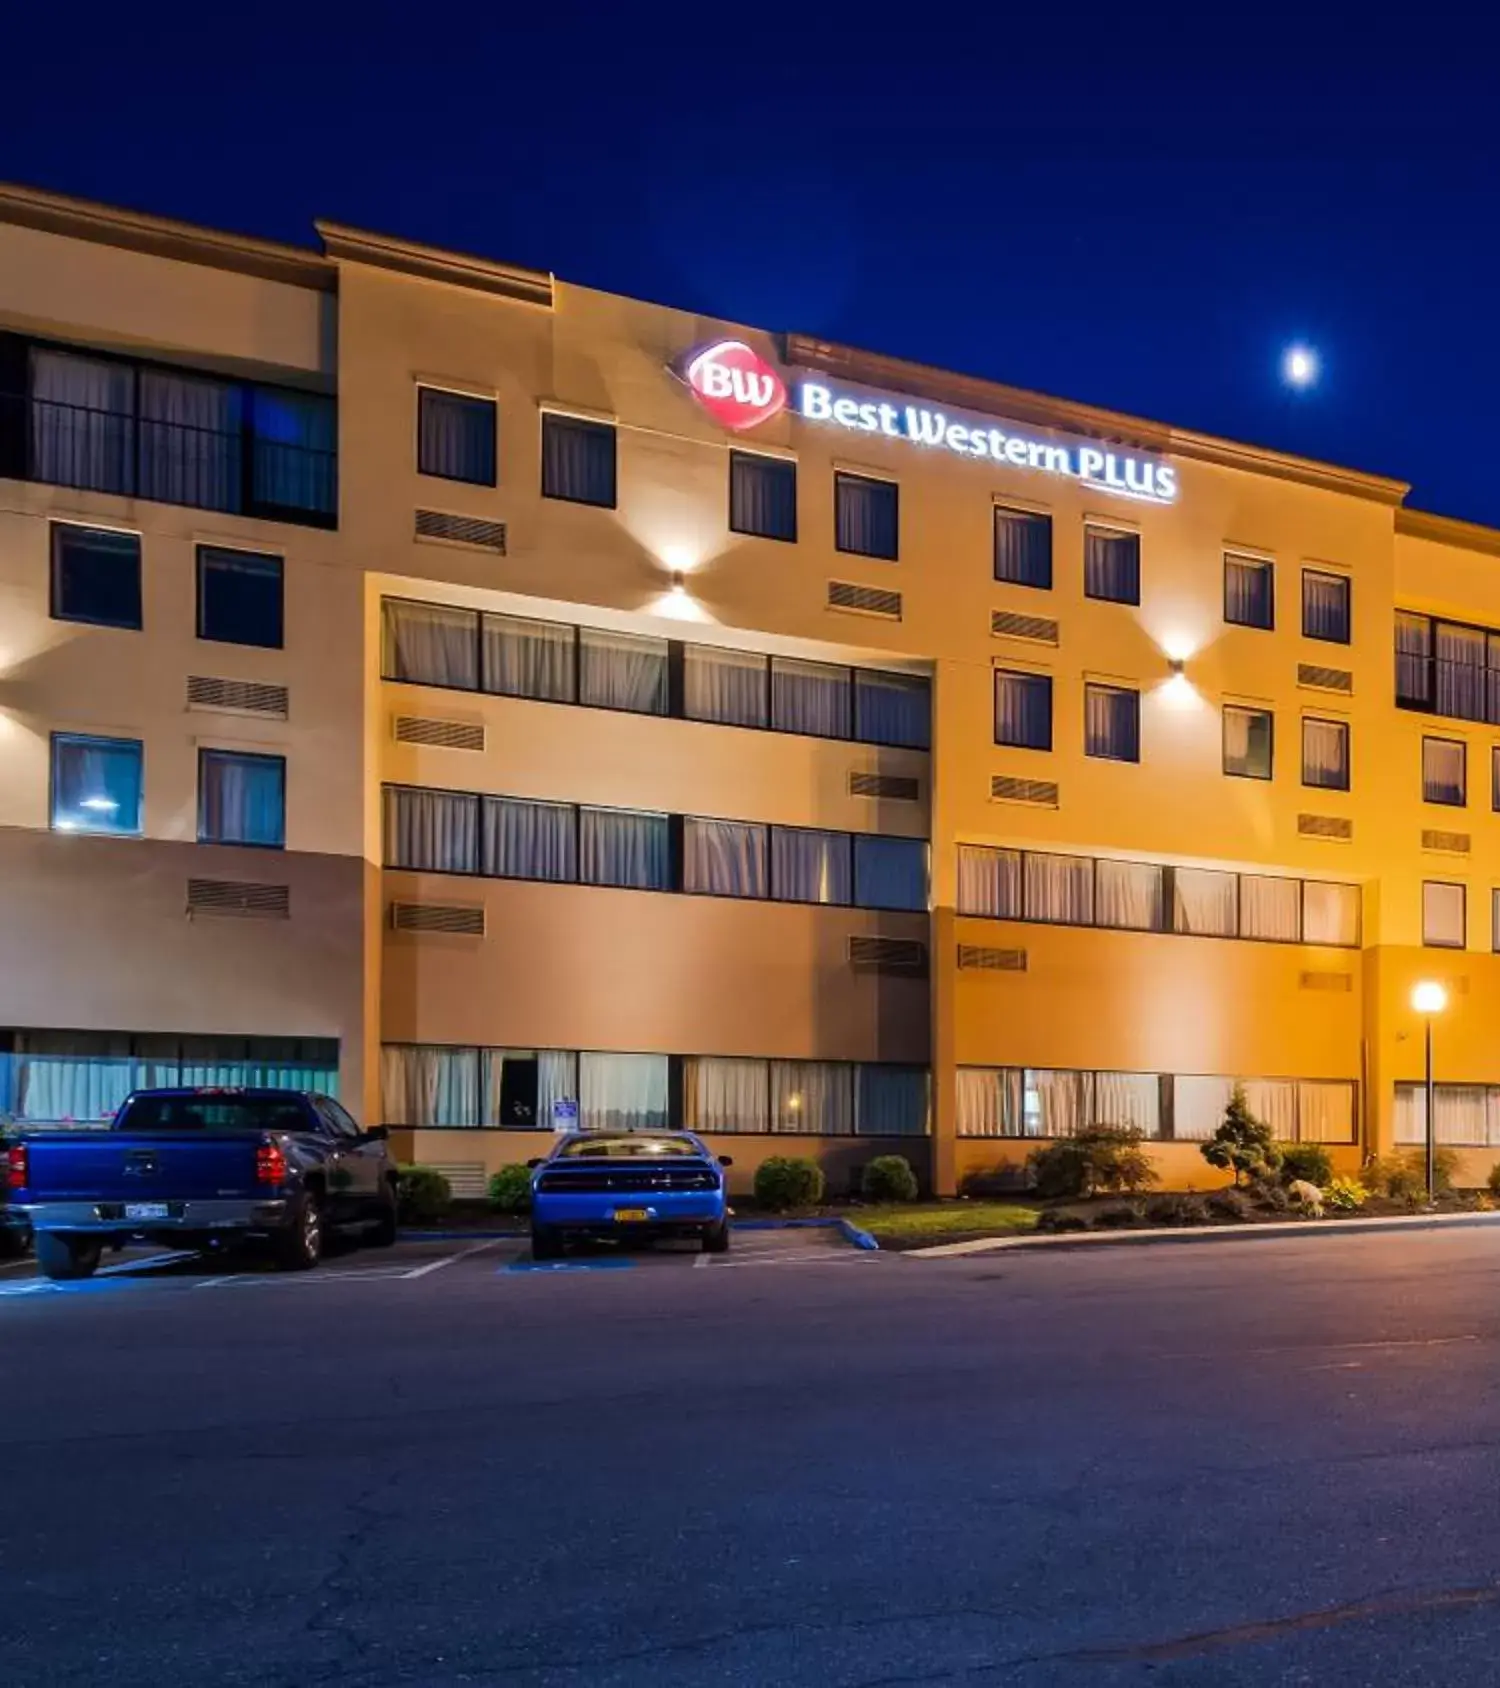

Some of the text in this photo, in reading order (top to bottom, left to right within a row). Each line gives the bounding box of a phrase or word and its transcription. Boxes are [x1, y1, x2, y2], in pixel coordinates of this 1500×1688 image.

[702, 363, 775, 407] BW
[802, 383, 1176, 498] Best Western PLUS
